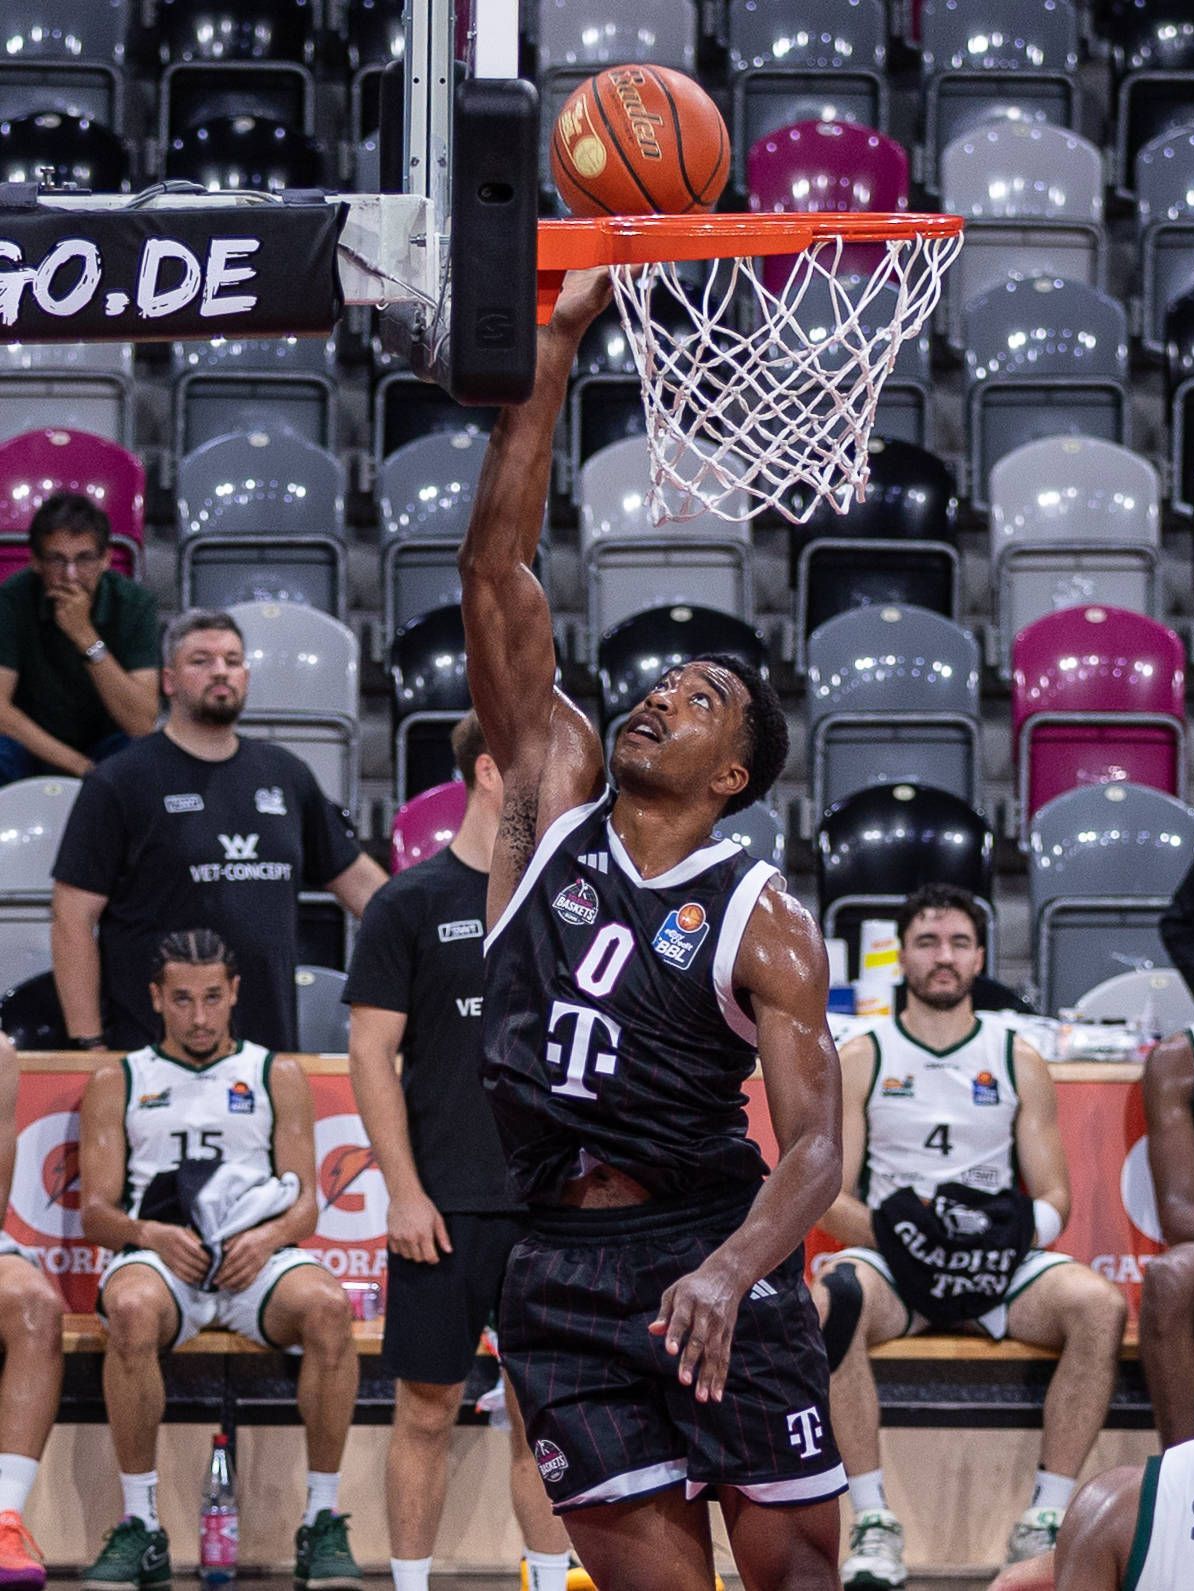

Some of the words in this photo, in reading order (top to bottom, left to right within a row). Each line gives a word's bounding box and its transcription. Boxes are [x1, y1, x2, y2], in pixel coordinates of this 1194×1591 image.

[608, 70, 664, 161] Baden
[556, 896, 595, 922] BASKETS
[575, 922, 635, 998] 0
[655, 940, 686, 963] BBL
[455, 996, 484, 1017] VE
[170, 1131, 224, 1162] 15
[924, 1124, 953, 1156] 4
